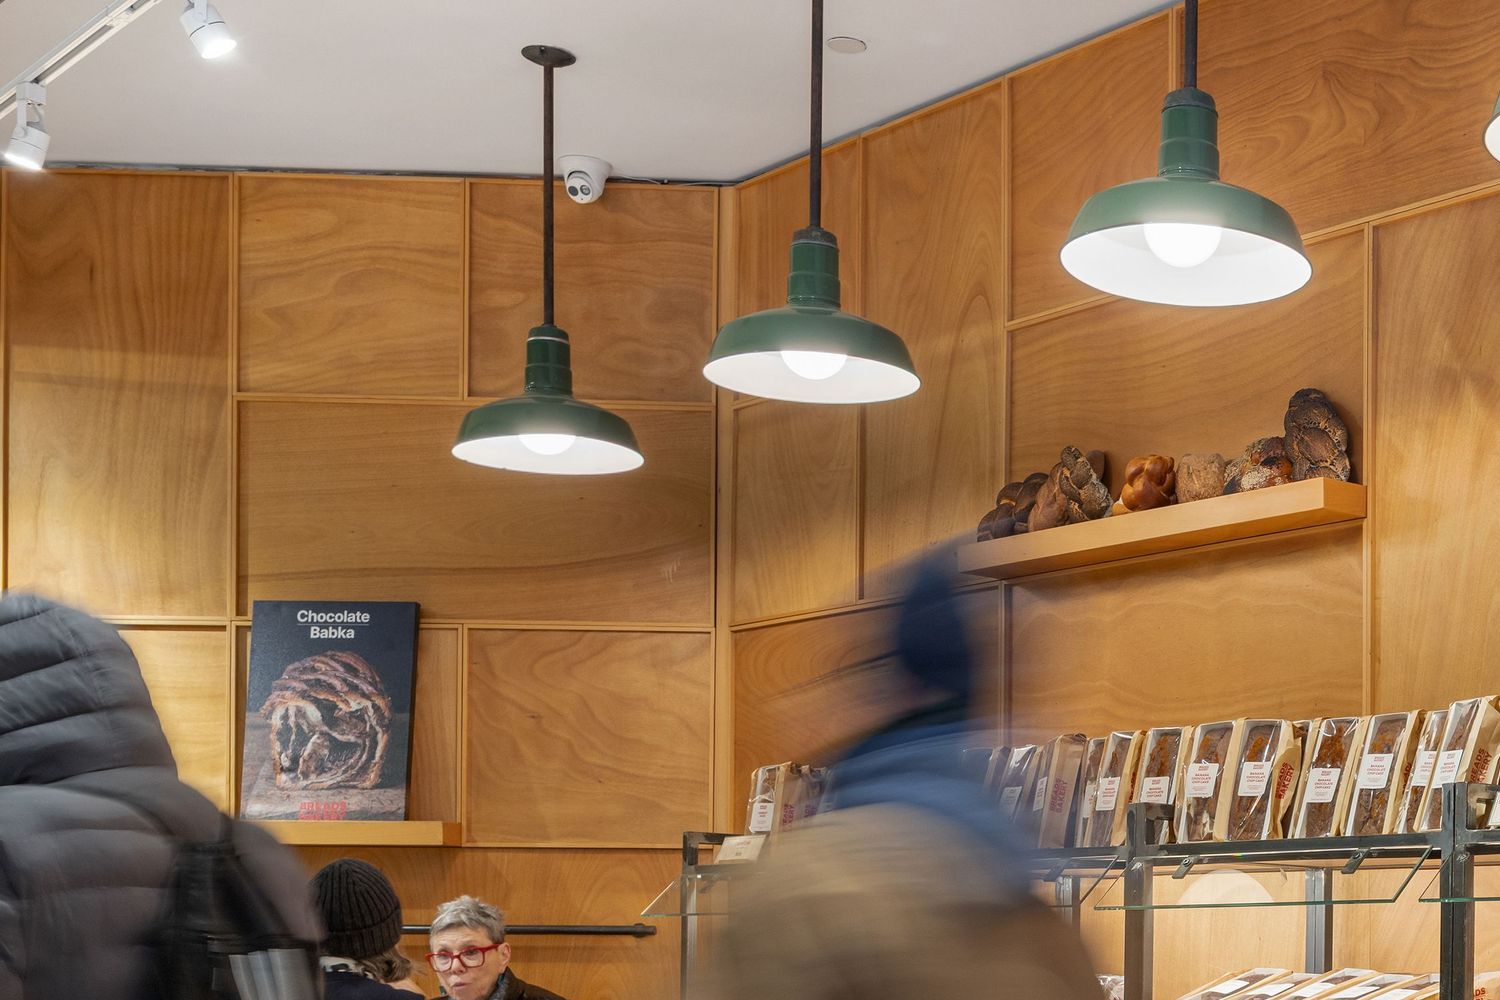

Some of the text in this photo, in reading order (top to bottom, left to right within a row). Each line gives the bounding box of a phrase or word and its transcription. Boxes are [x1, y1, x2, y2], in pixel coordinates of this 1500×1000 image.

[297, 609, 370, 623] Chocolate
[310, 626, 355, 639] Babka
[300, 801, 346, 811] BREADS
